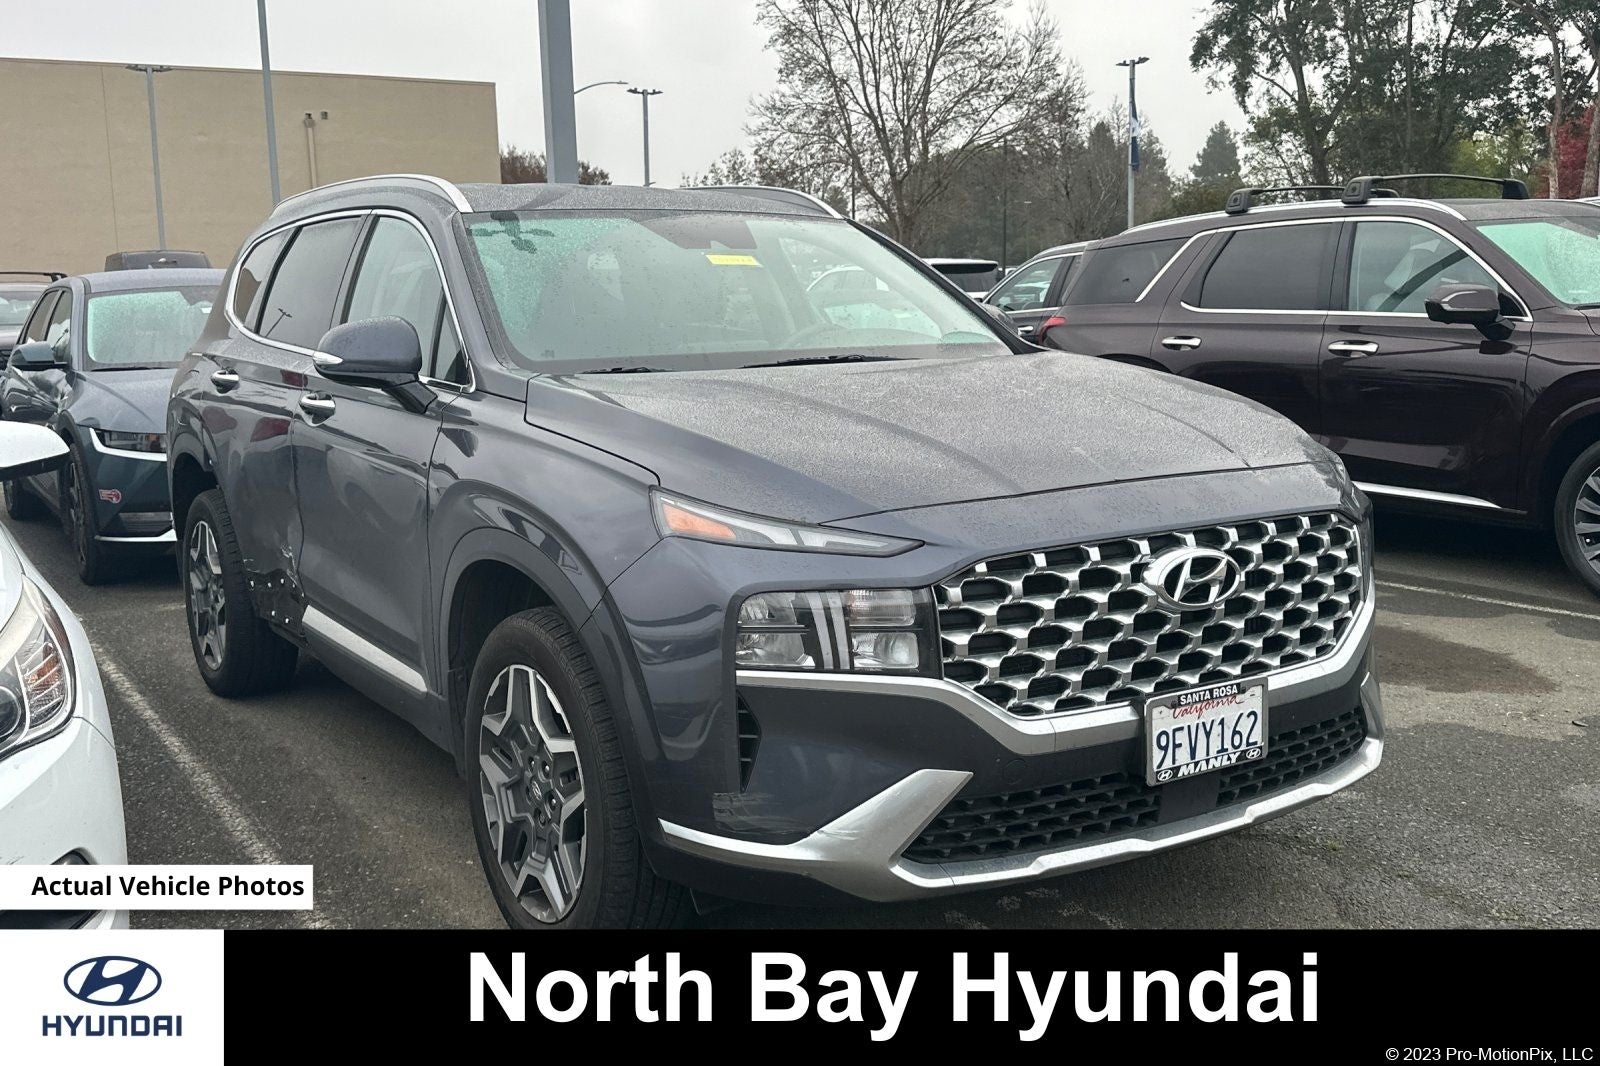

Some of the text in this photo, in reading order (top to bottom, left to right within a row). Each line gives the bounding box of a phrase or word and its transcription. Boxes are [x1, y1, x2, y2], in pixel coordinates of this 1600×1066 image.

[1172, 694, 1245, 719] California
[1180, 684, 1239, 705] SANTA ROSA
[1156, 710, 1258, 770] 9FVY162
[1177, 752, 1242, 778] MANLY
